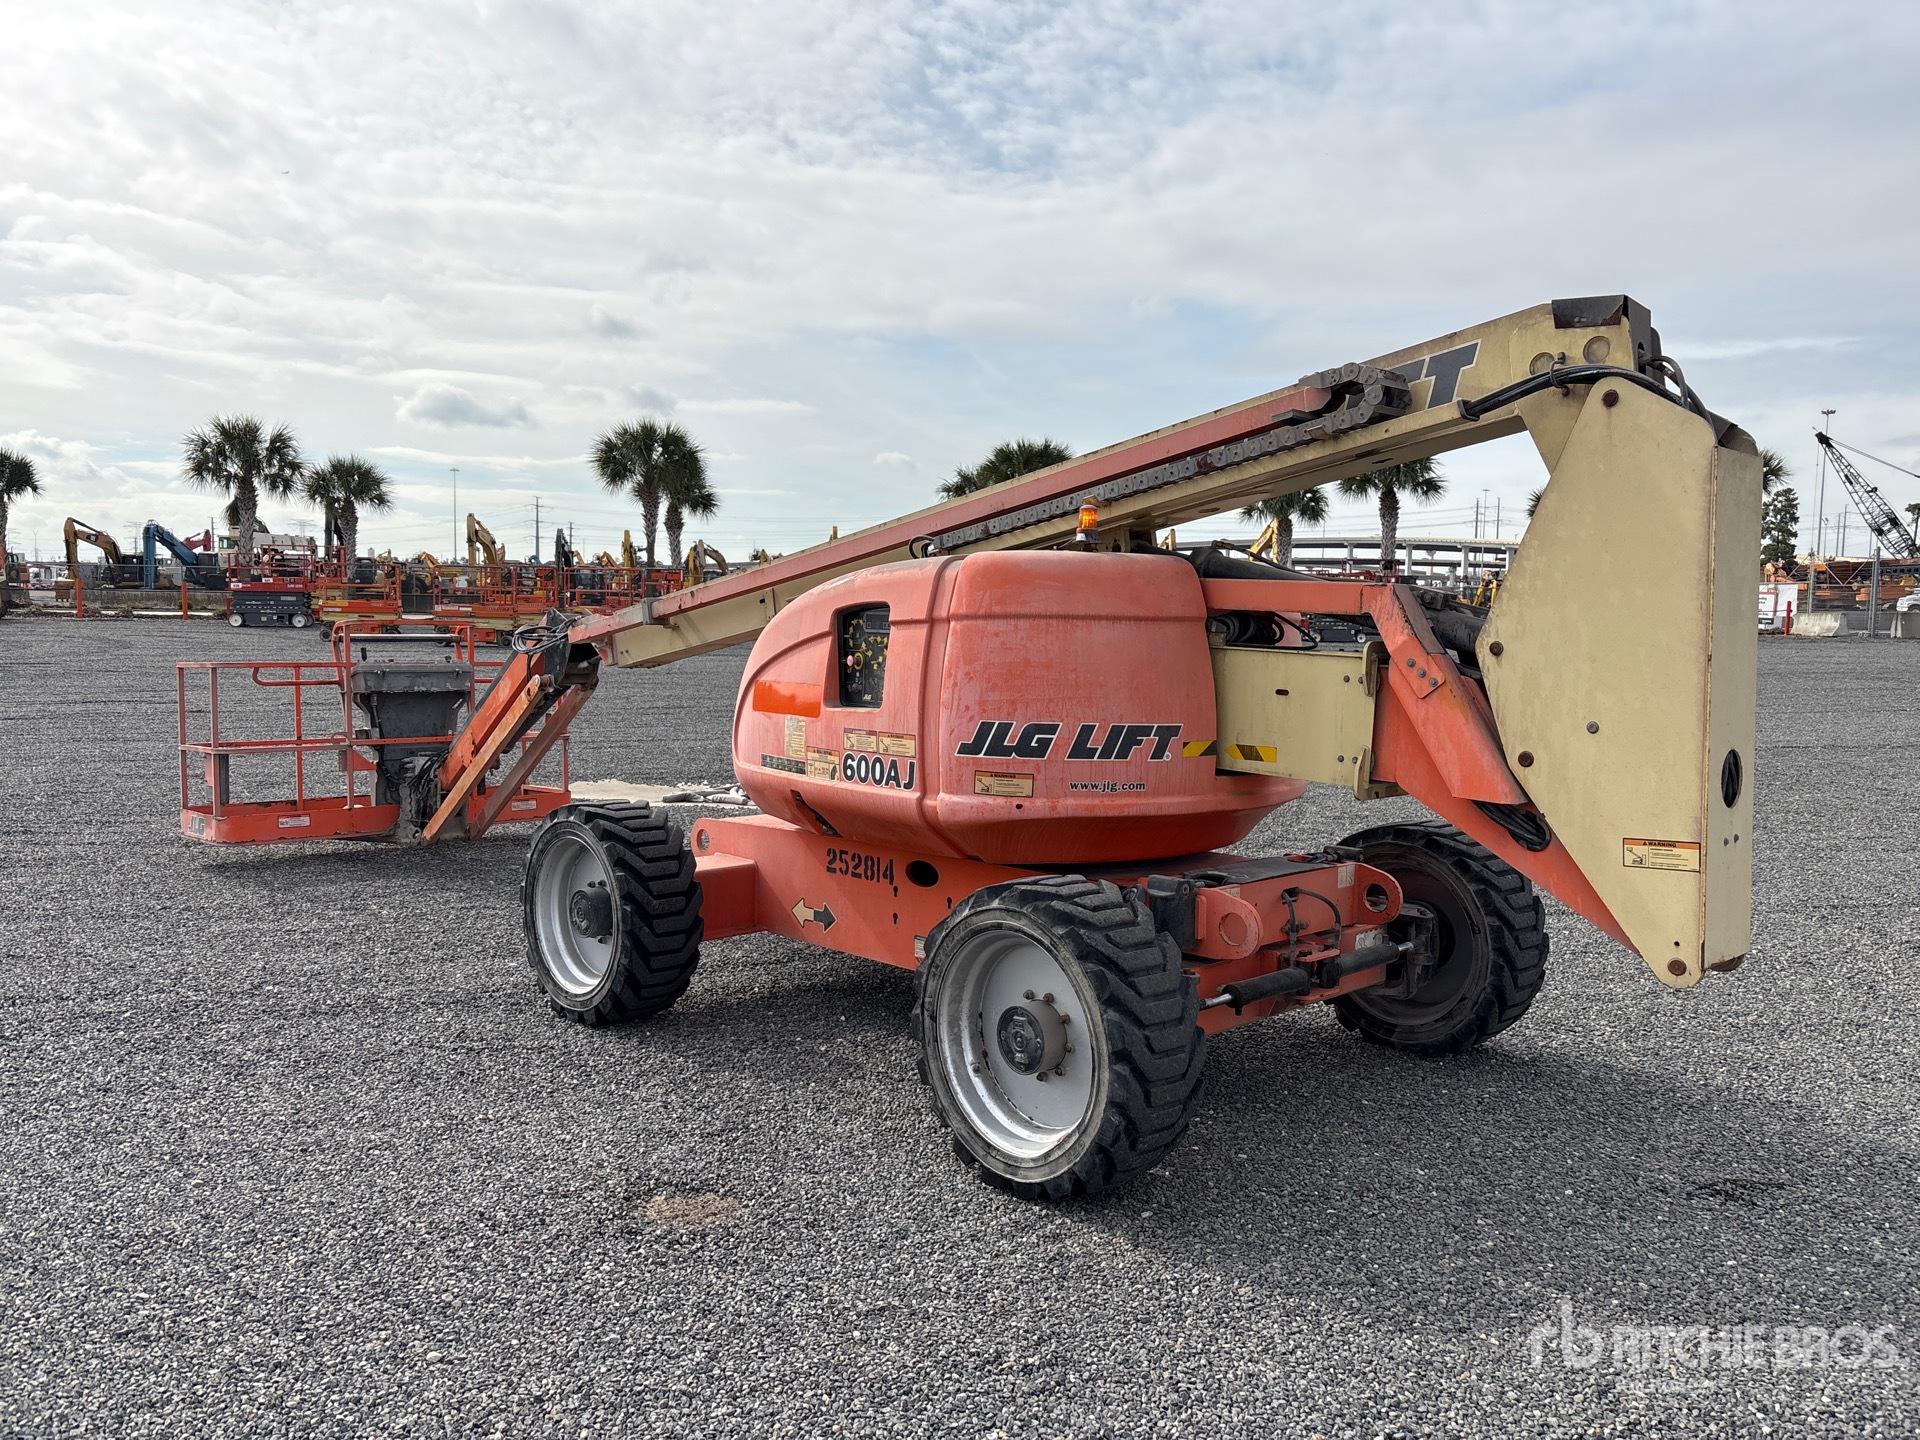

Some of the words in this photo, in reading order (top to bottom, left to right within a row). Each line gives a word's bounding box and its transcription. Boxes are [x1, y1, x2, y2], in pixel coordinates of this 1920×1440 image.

[956, 720, 1061, 760] JLG
[1065, 722, 1182, 762] LIFT
[842, 752, 916, 791] 600AJ
[1069, 781, 1146, 793] www.jlg.com
[189, 815, 206, 836] JLG
[826, 847, 895, 885] 252814
